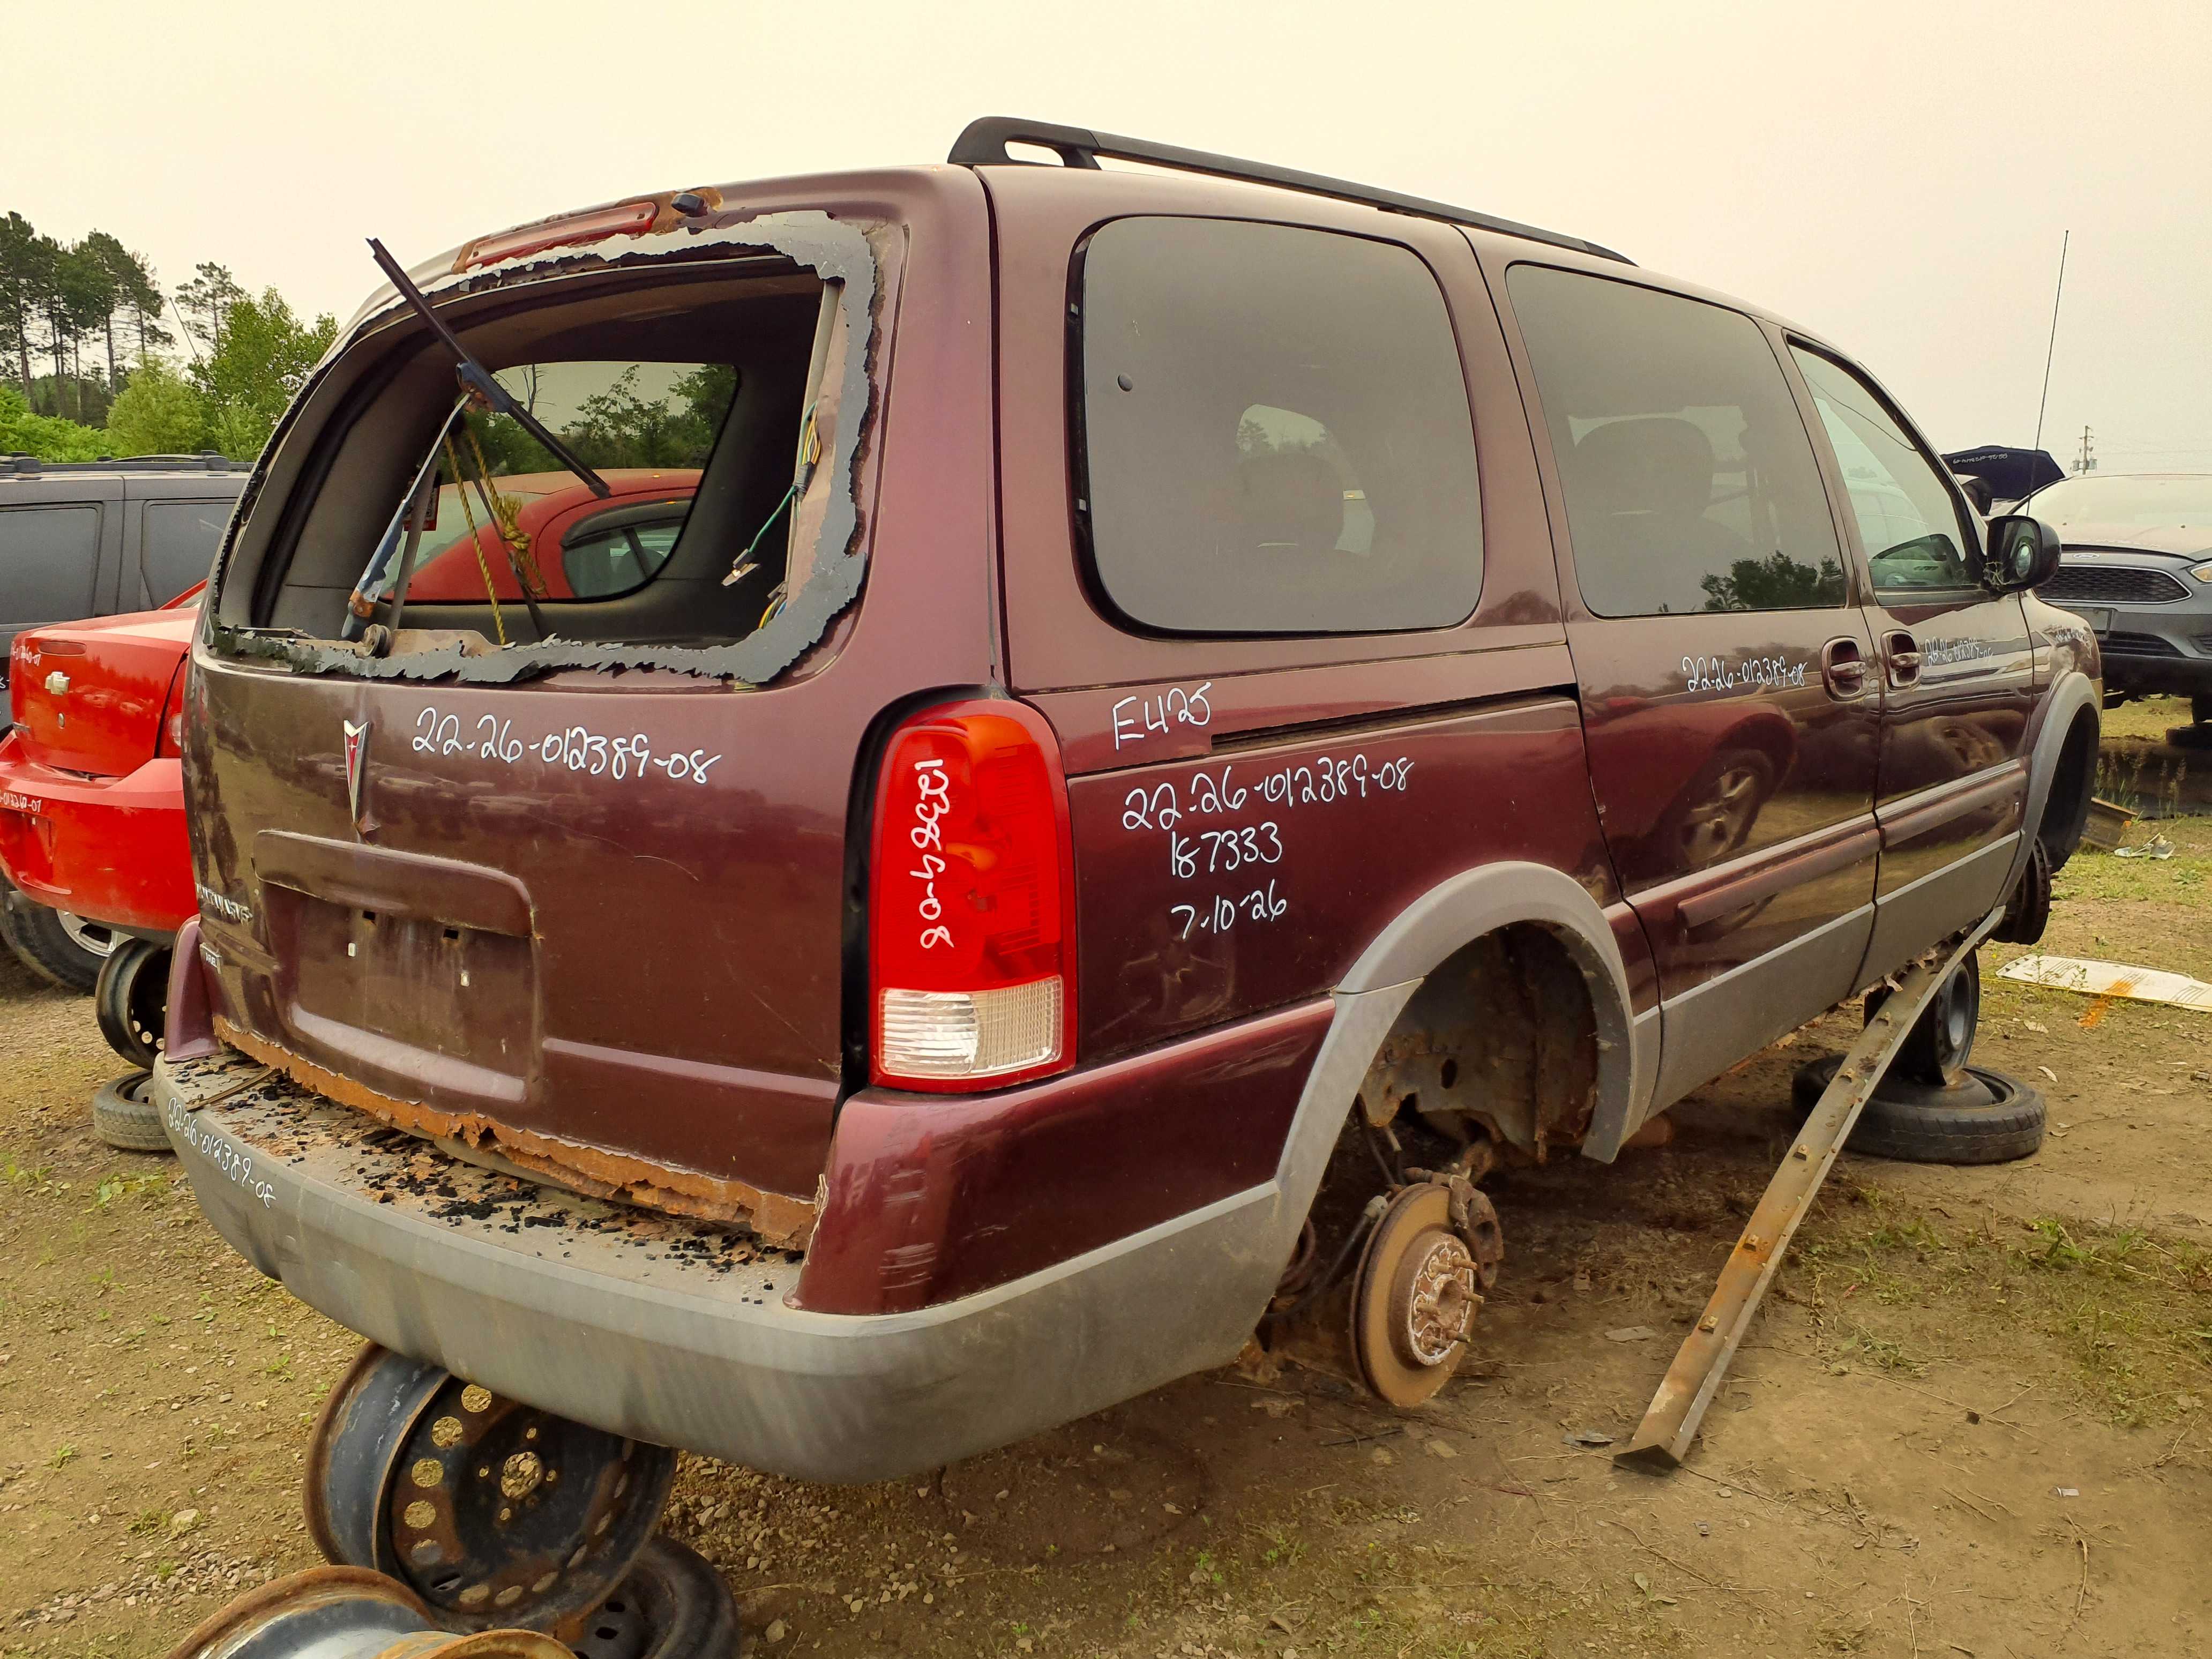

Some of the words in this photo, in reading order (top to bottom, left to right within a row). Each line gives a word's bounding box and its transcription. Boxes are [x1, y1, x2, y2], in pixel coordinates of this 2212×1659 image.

[1682, 655, 1808, 692] 22-26-012389-08
[412, 706, 722, 784] 22-26-012389-08
[1122, 753, 1415, 831] 22-26-012389-08
[909, 758, 955, 950] 12389-08
